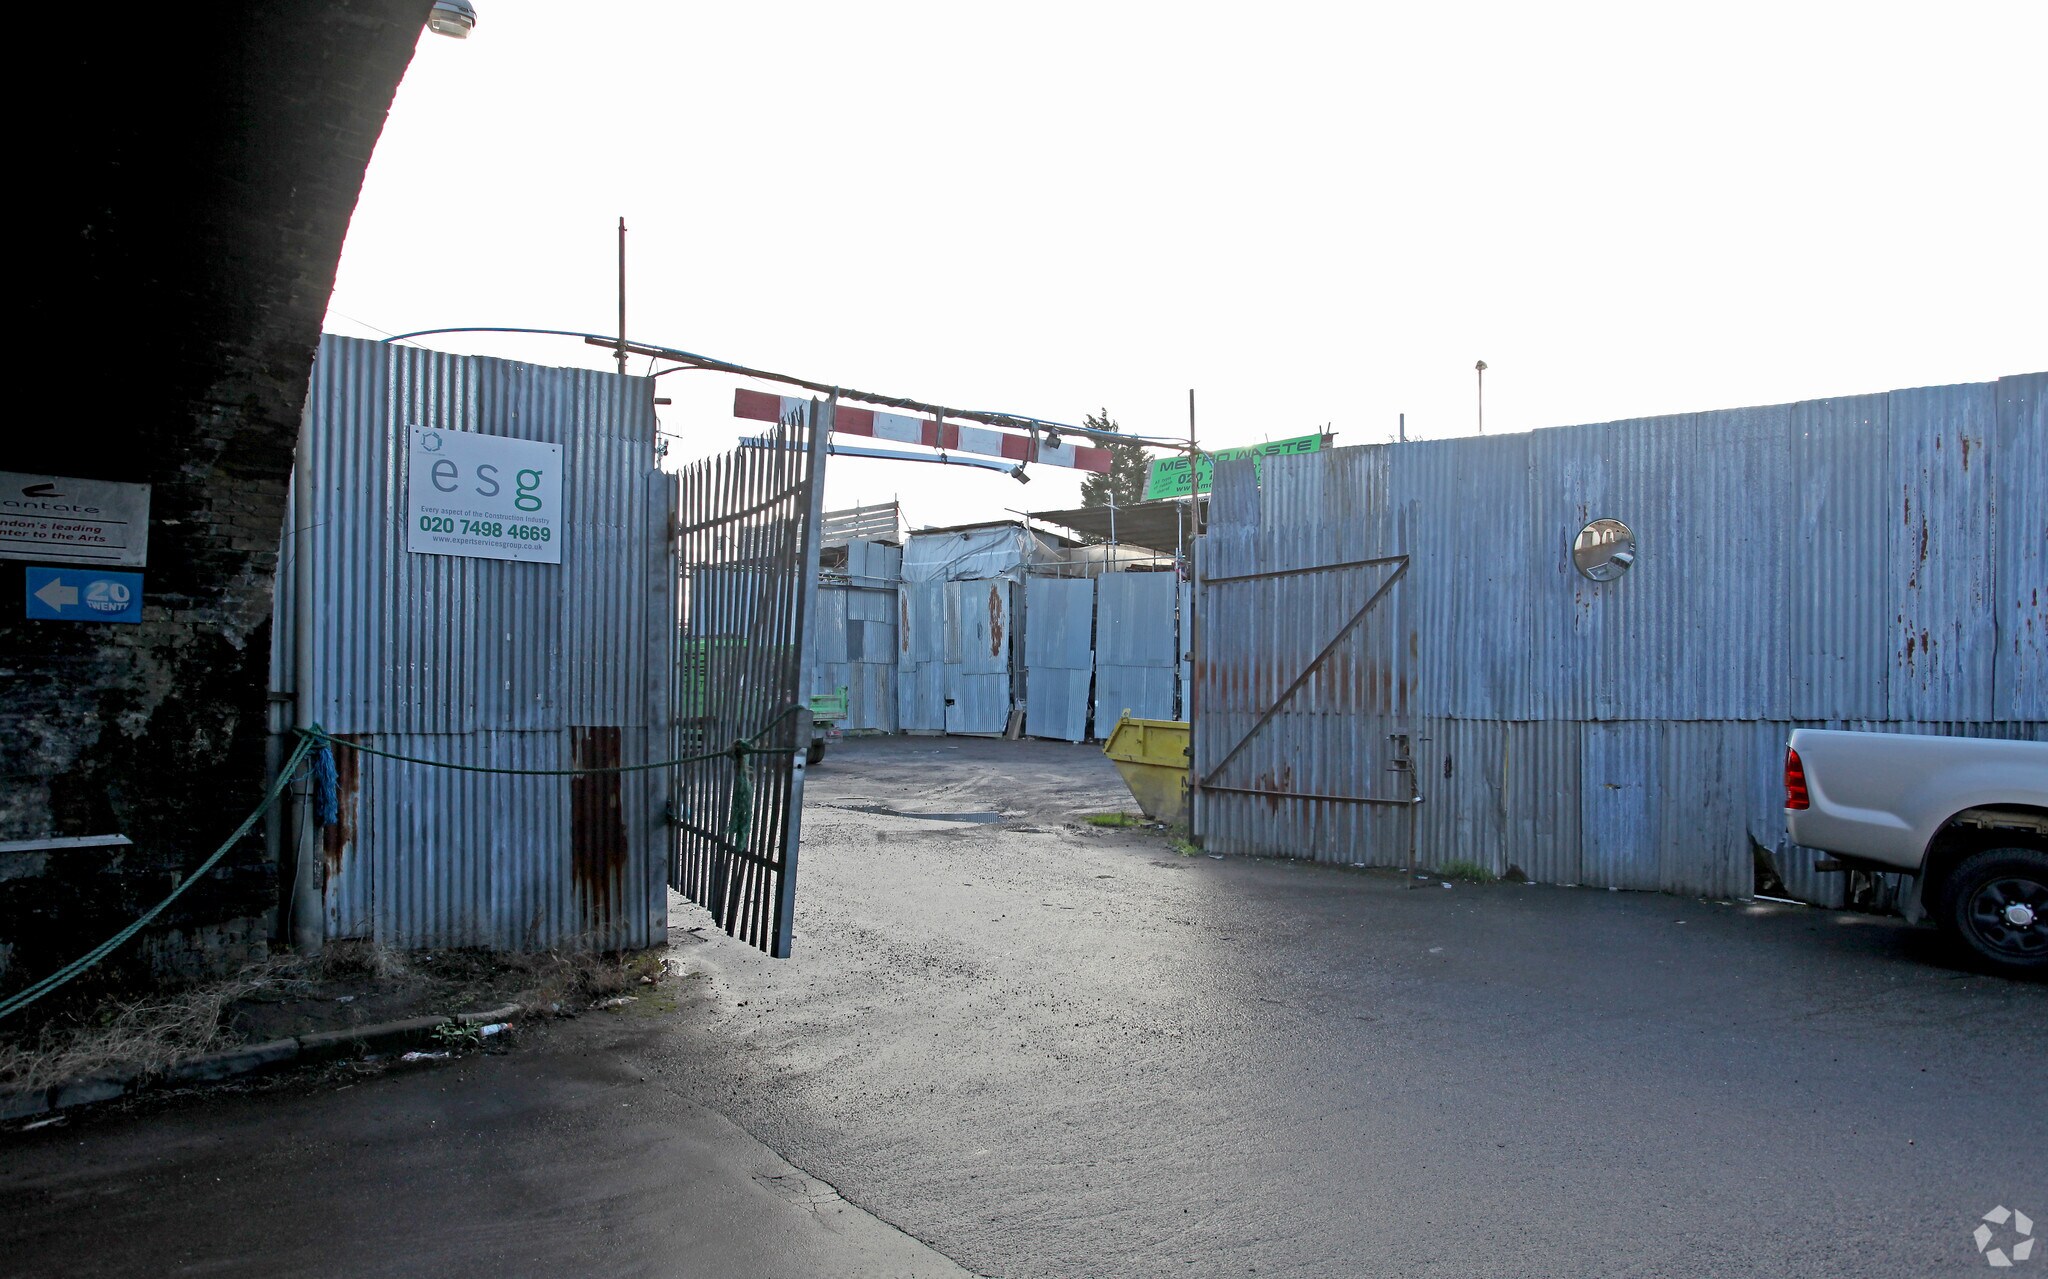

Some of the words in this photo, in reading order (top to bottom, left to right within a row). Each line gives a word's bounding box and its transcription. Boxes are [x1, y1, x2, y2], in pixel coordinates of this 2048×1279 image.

[431, 459, 543, 512] esg
[421, 505, 439, 515] Every
[441, 507, 463, 517] aspect
[465, 509, 472, 517] of
[473, 510, 483, 518] the
[484, 511, 524, 522] Construction
[525, 515, 550, 525] Industry
[52, 523, 102, 534] leading
[52, 532, 74, 540] the
[78, 534, 106, 542] Arts
[419, 515, 454, 533] 020
[459, 519, 503, 538] 7498
[508, 524, 551, 542] 4669
[433, 535, 543, 551] www.expertservicesgroup.co.uk
[88, 582, 130, 602] 20
[87, 601, 129, 612] TWENTY
